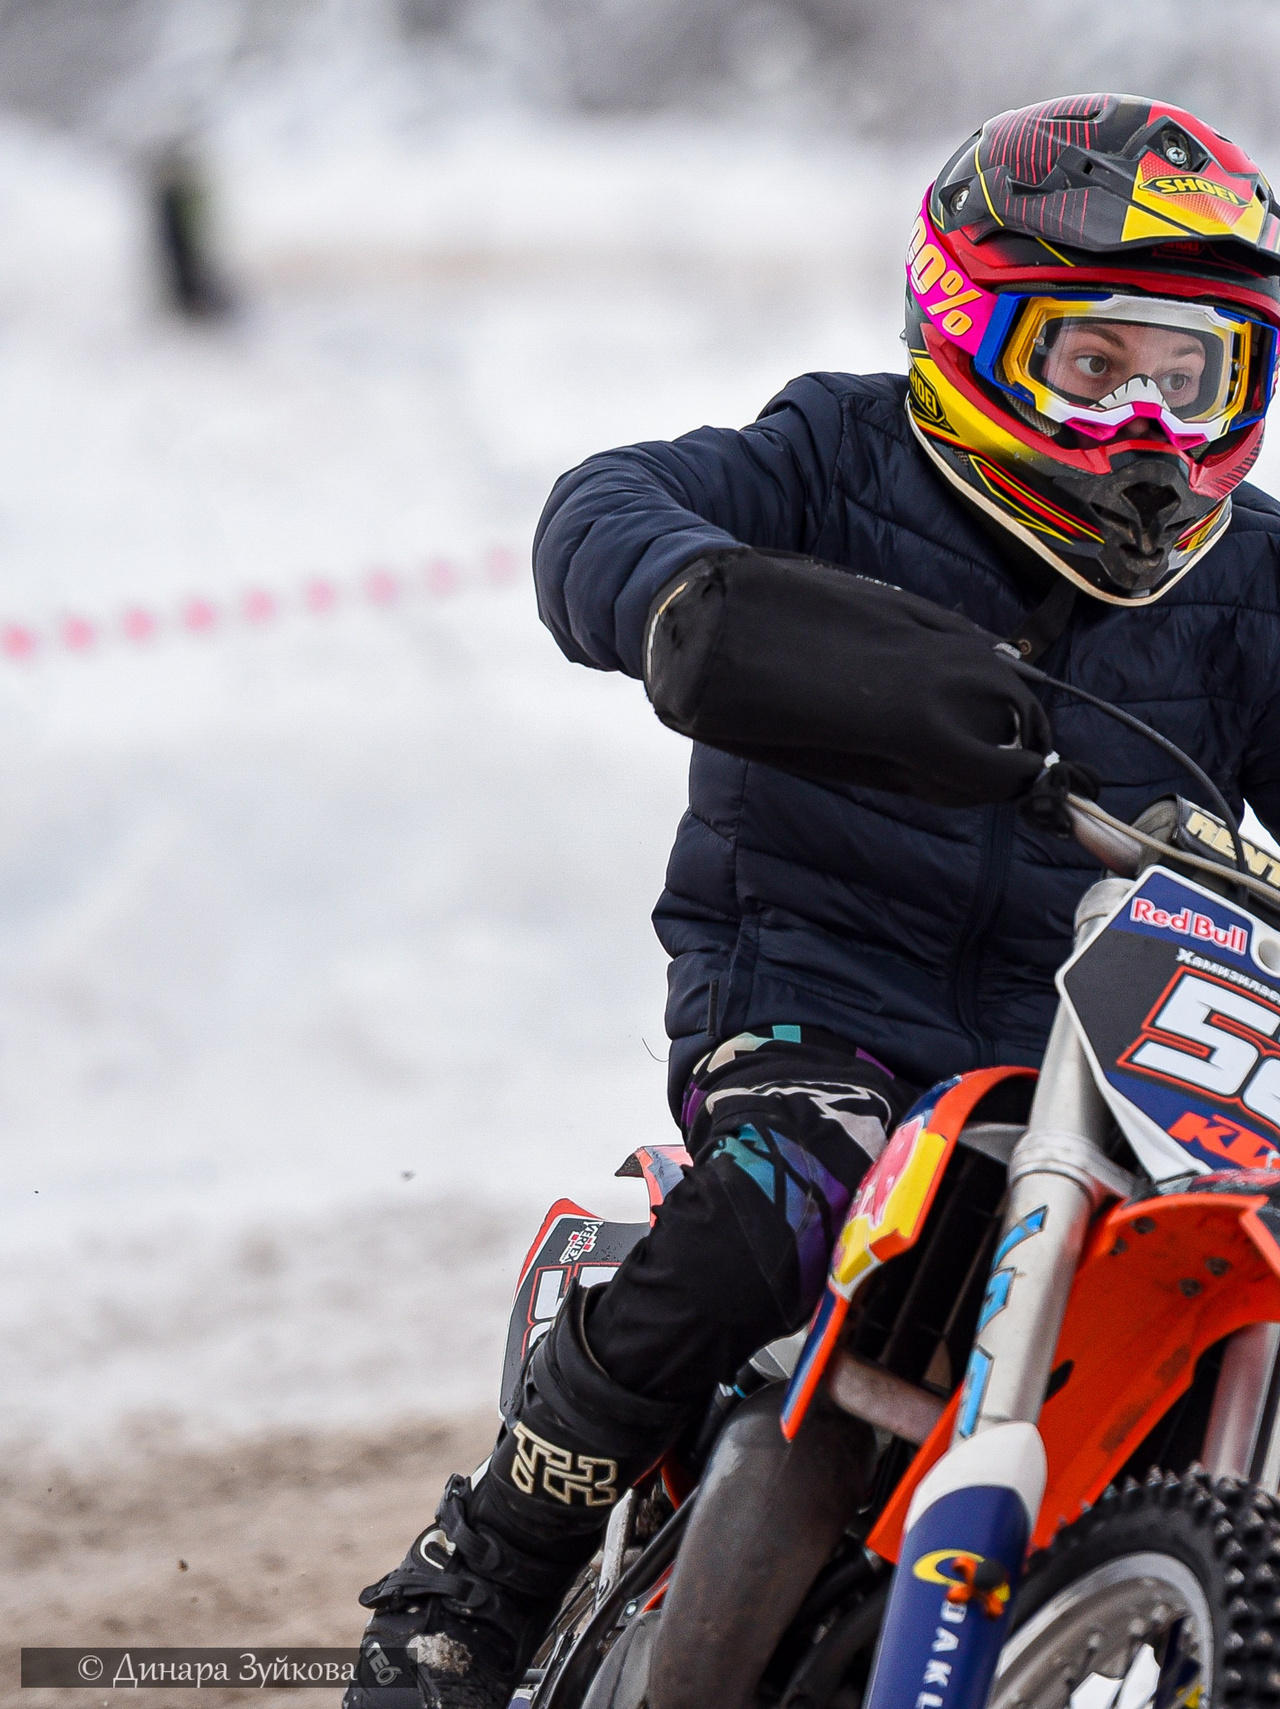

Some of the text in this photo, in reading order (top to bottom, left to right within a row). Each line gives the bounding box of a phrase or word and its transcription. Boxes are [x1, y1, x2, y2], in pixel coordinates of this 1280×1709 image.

[1155, 178, 1239, 205] SHOEI
[1131, 898, 1248, 955] Red Bull
[563, 1221, 604, 1263] VERTEX
